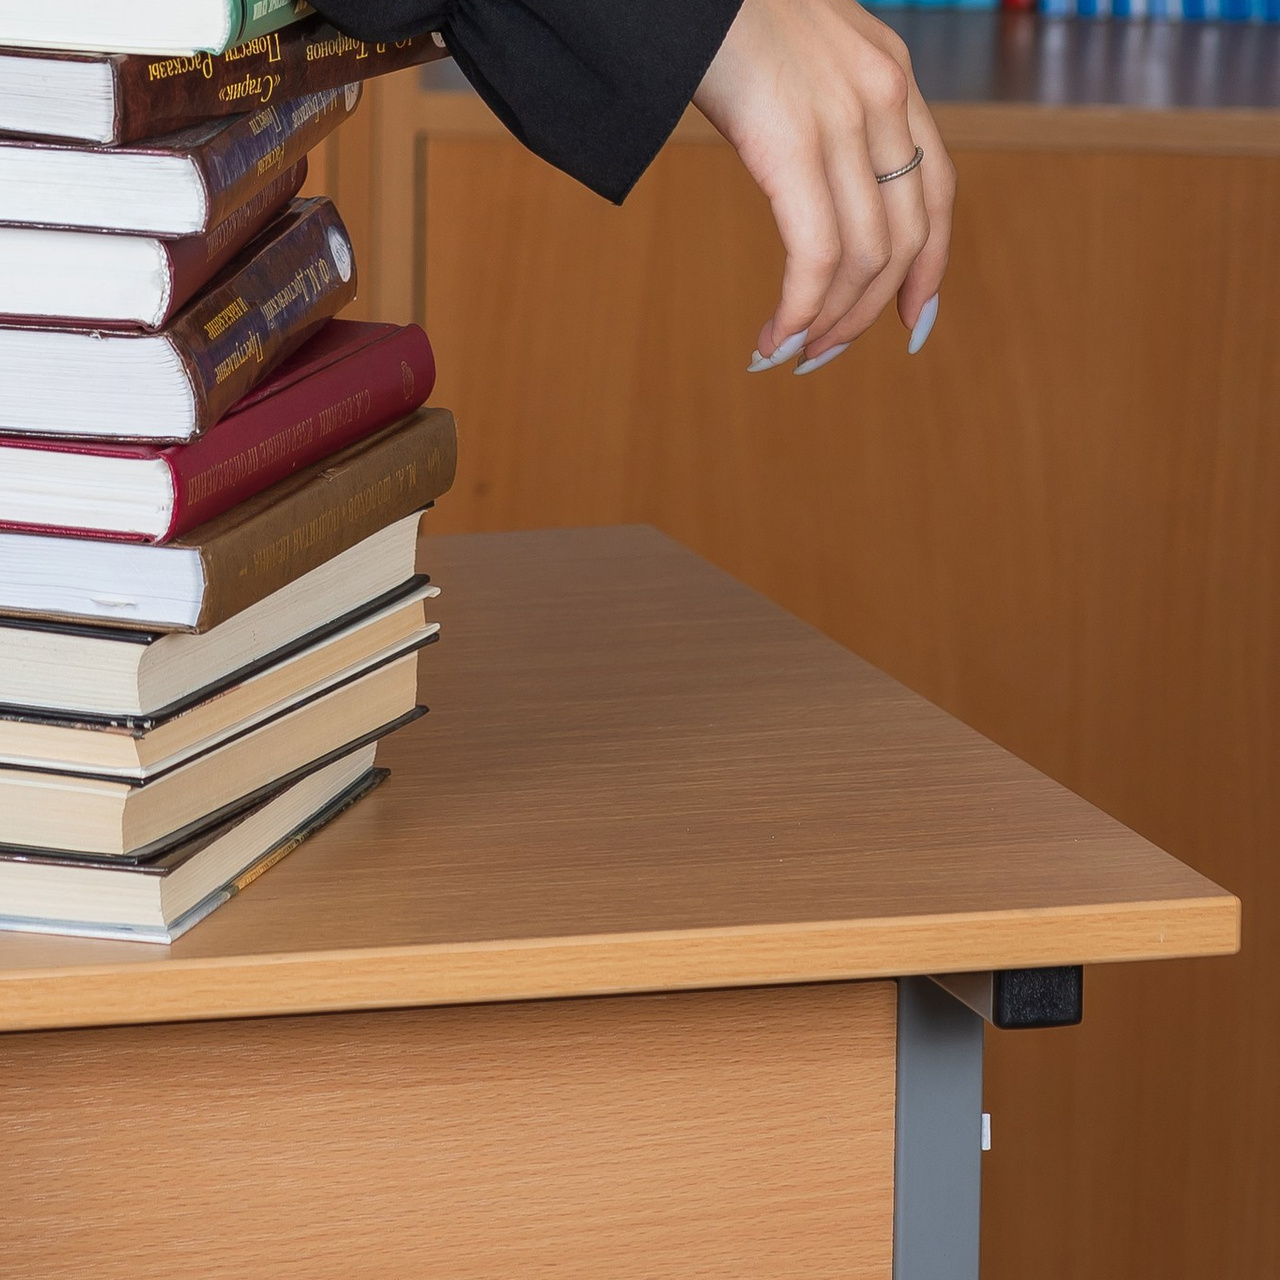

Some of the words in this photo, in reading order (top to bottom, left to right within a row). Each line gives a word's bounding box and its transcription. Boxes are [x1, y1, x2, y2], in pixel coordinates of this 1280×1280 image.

[225, 33, 282, 63] Повести
[148, 52, 214, 81] Рассказы
[218, 73, 282, 102] «Старик»
[248, 104, 282, 133] Повести
[257, 141, 285, 177] Рассказы
[262, 268, 310, 329] Достоевский
[203, 300, 245, 340] наказание
[214, 330, 264, 385] Преступление
